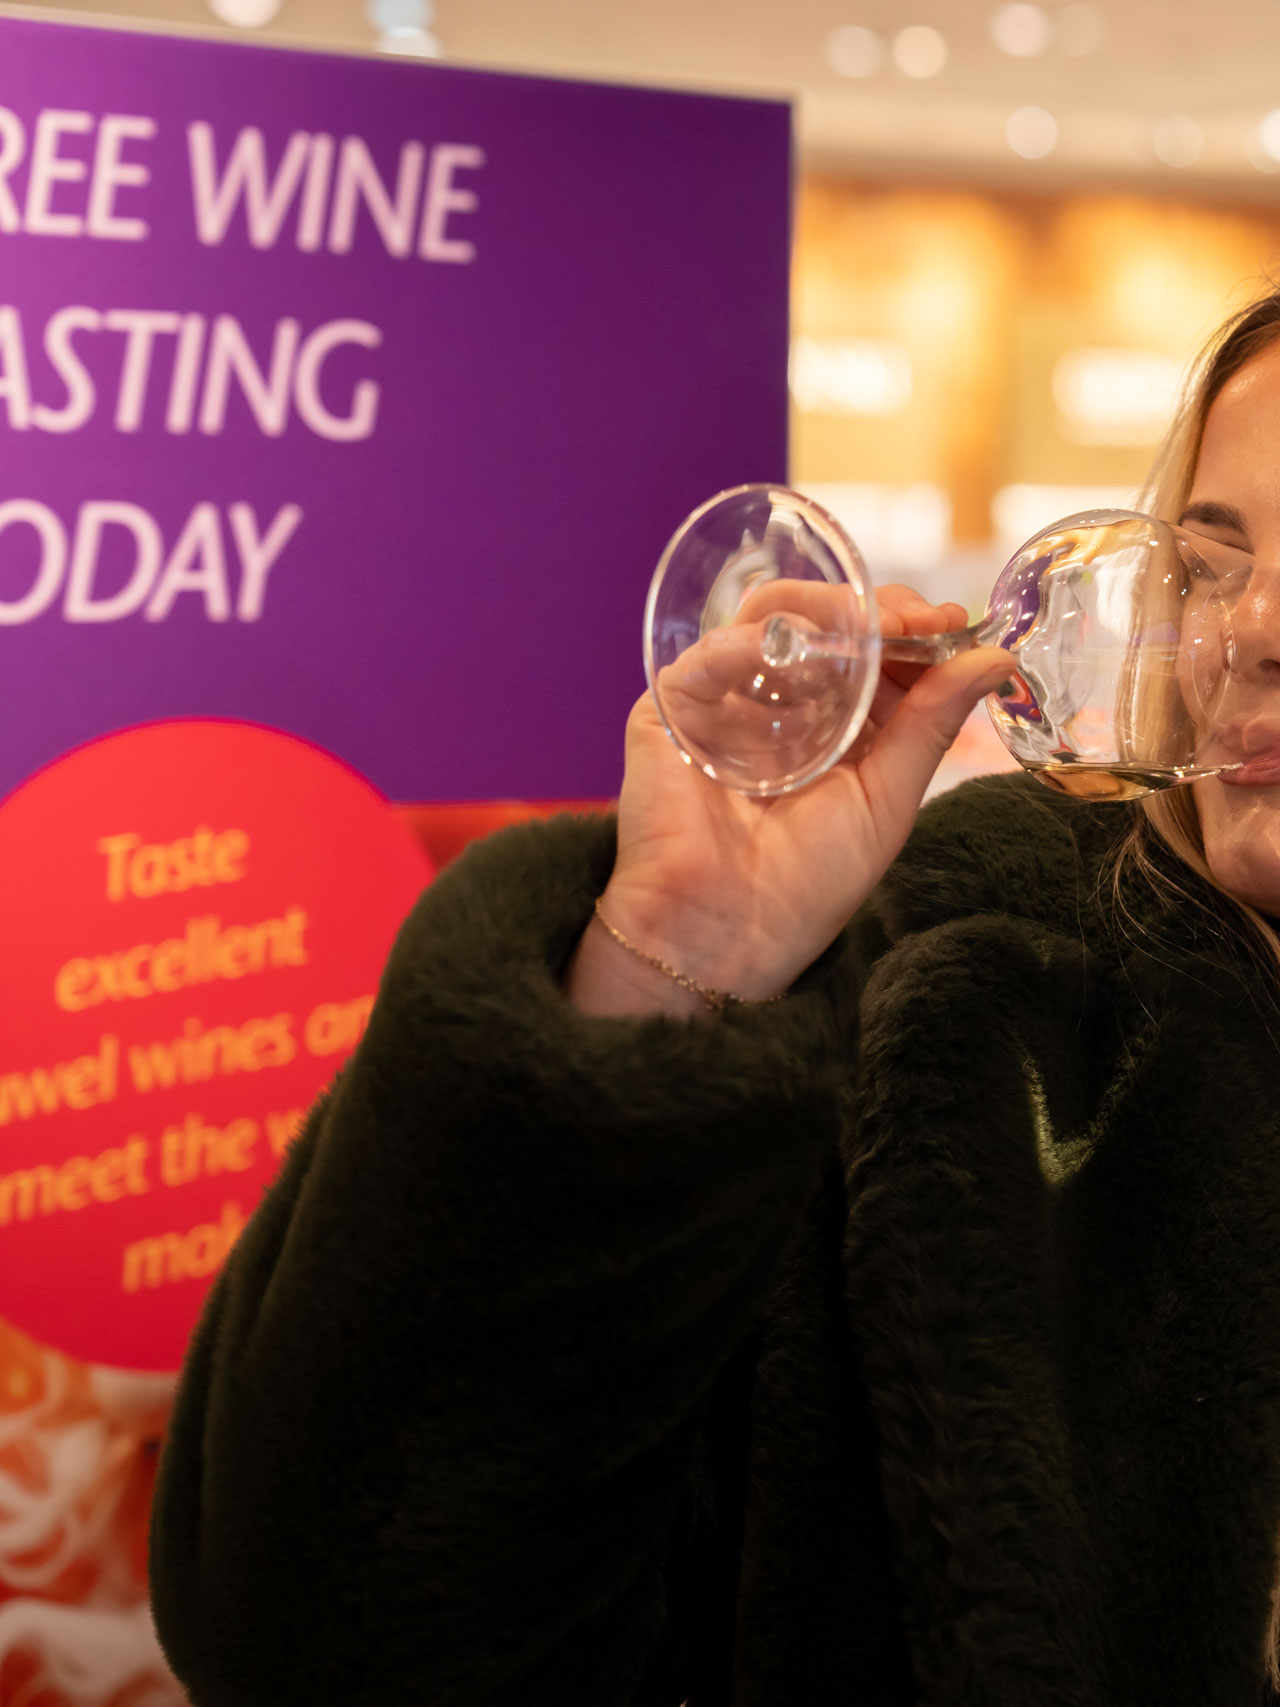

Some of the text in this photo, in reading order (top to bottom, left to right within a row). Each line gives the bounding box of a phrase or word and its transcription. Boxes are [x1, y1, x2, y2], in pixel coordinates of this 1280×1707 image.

[187, 120, 483, 264] WINE
[97, 827, 249, 902] Taste
[55, 906, 307, 1012] excellent
[128, 1017, 296, 1092] wines
[161, 1114, 260, 1187] the
